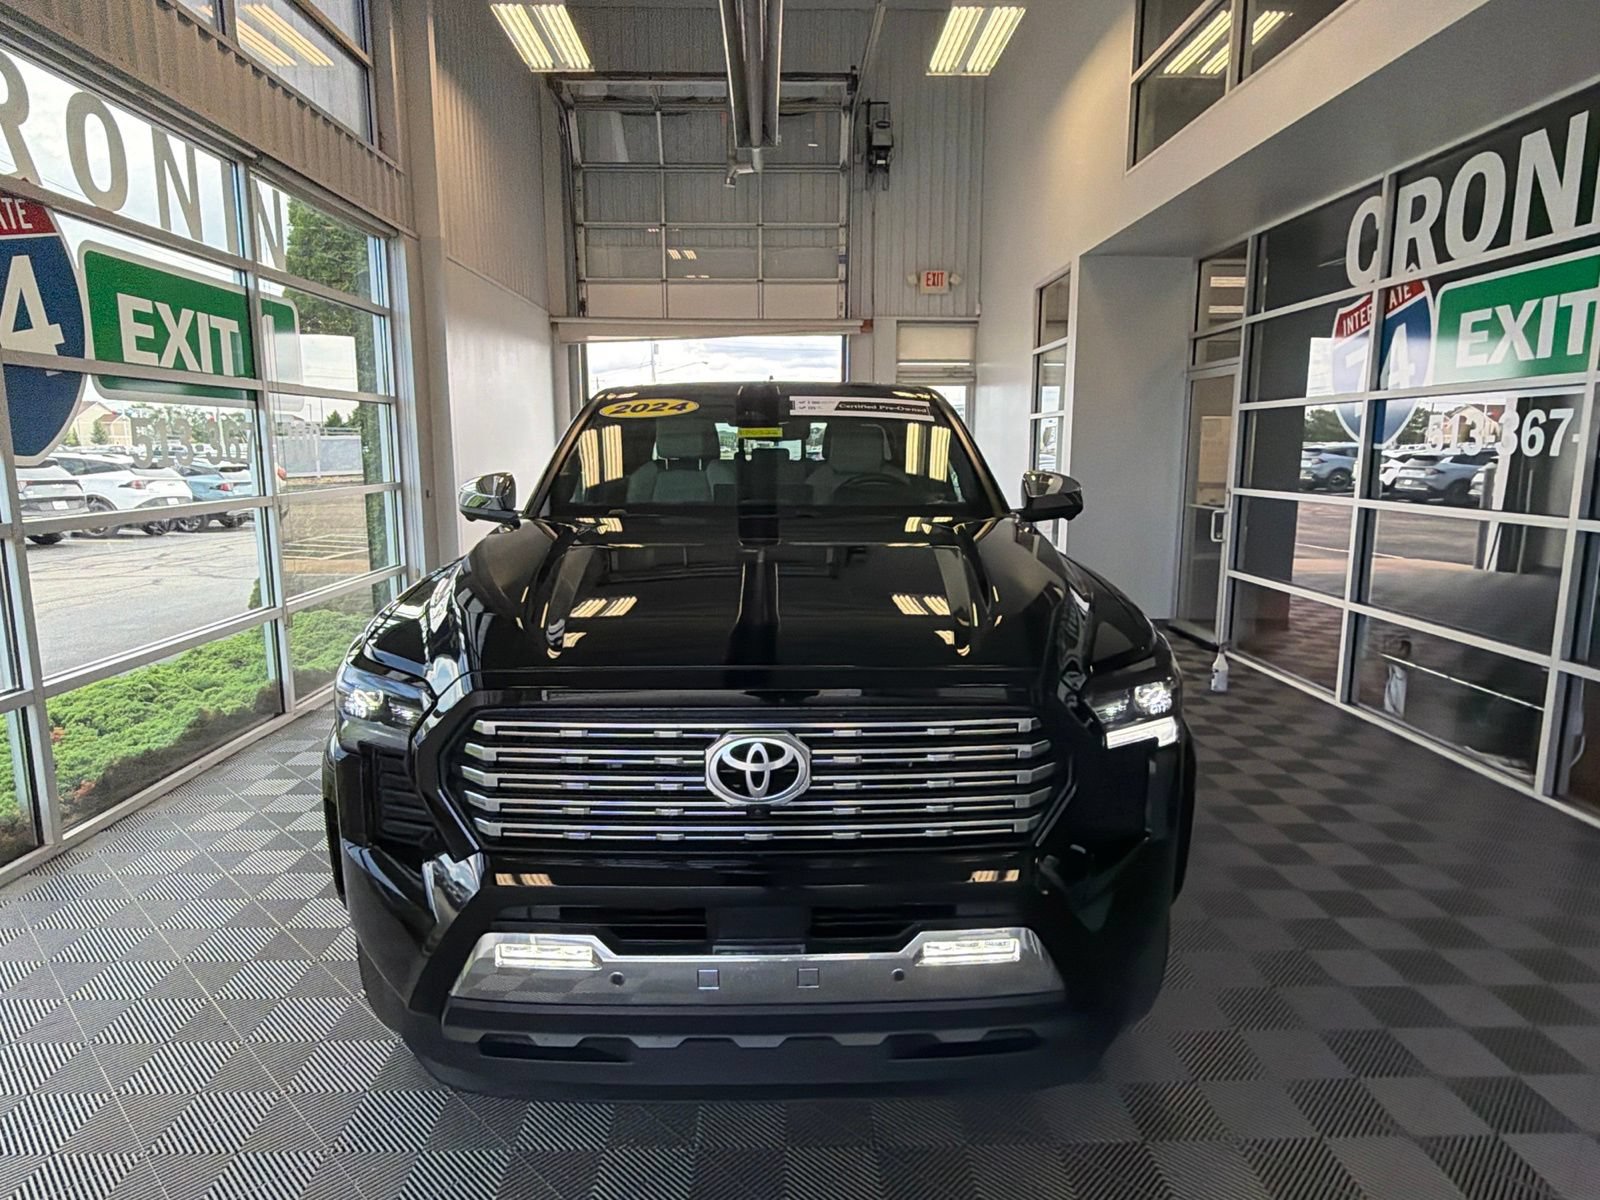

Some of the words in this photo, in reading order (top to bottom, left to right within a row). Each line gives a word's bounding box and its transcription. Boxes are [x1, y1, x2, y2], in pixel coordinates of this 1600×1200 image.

[1345, 110, 1600, 287] CRON
[926, 272, 944, 287] EXIT
[117, 293, 241, 377] EXIT
[1456, 287, 1599, 368] EXIT
[609, 402, 689, 415] 2024
[838, 402, 878, 411] Certified
[879, 404, 927, 413] Pre-Owned
